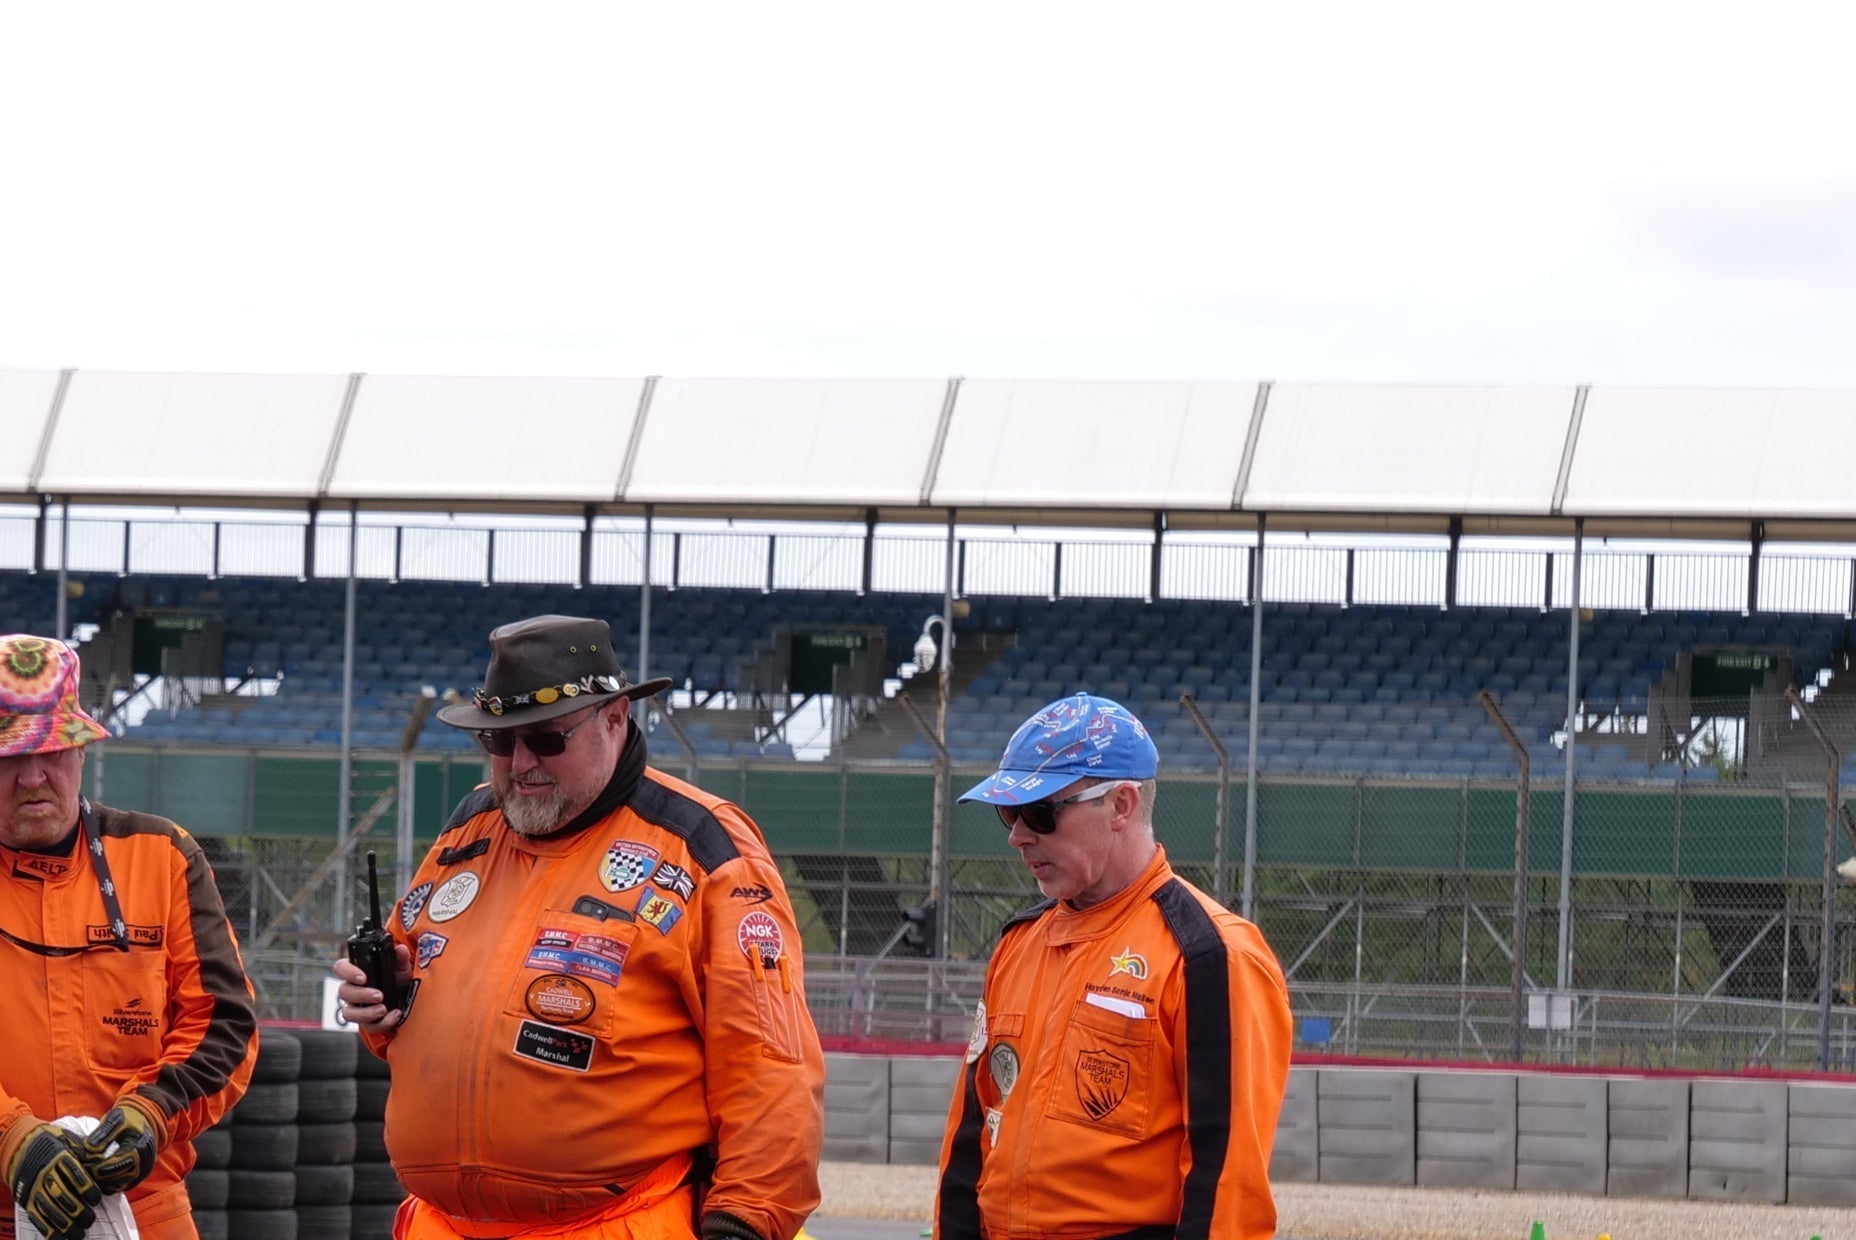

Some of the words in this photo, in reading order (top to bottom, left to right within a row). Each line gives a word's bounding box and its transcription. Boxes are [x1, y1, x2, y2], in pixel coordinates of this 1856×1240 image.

[746, 925, 774, 938] NGK
[538, 994, 581, 1008] MARSHALS
[102, 1016, 160, 1028] MARSHALS
[117, 1026, 148, 1036] TEAM
[535, 1047, 570, 1062] Marshal
[1080, 1061, 1125, 1080] MARSHALS
[1088, 1072, 1112, 1086] TEAM
